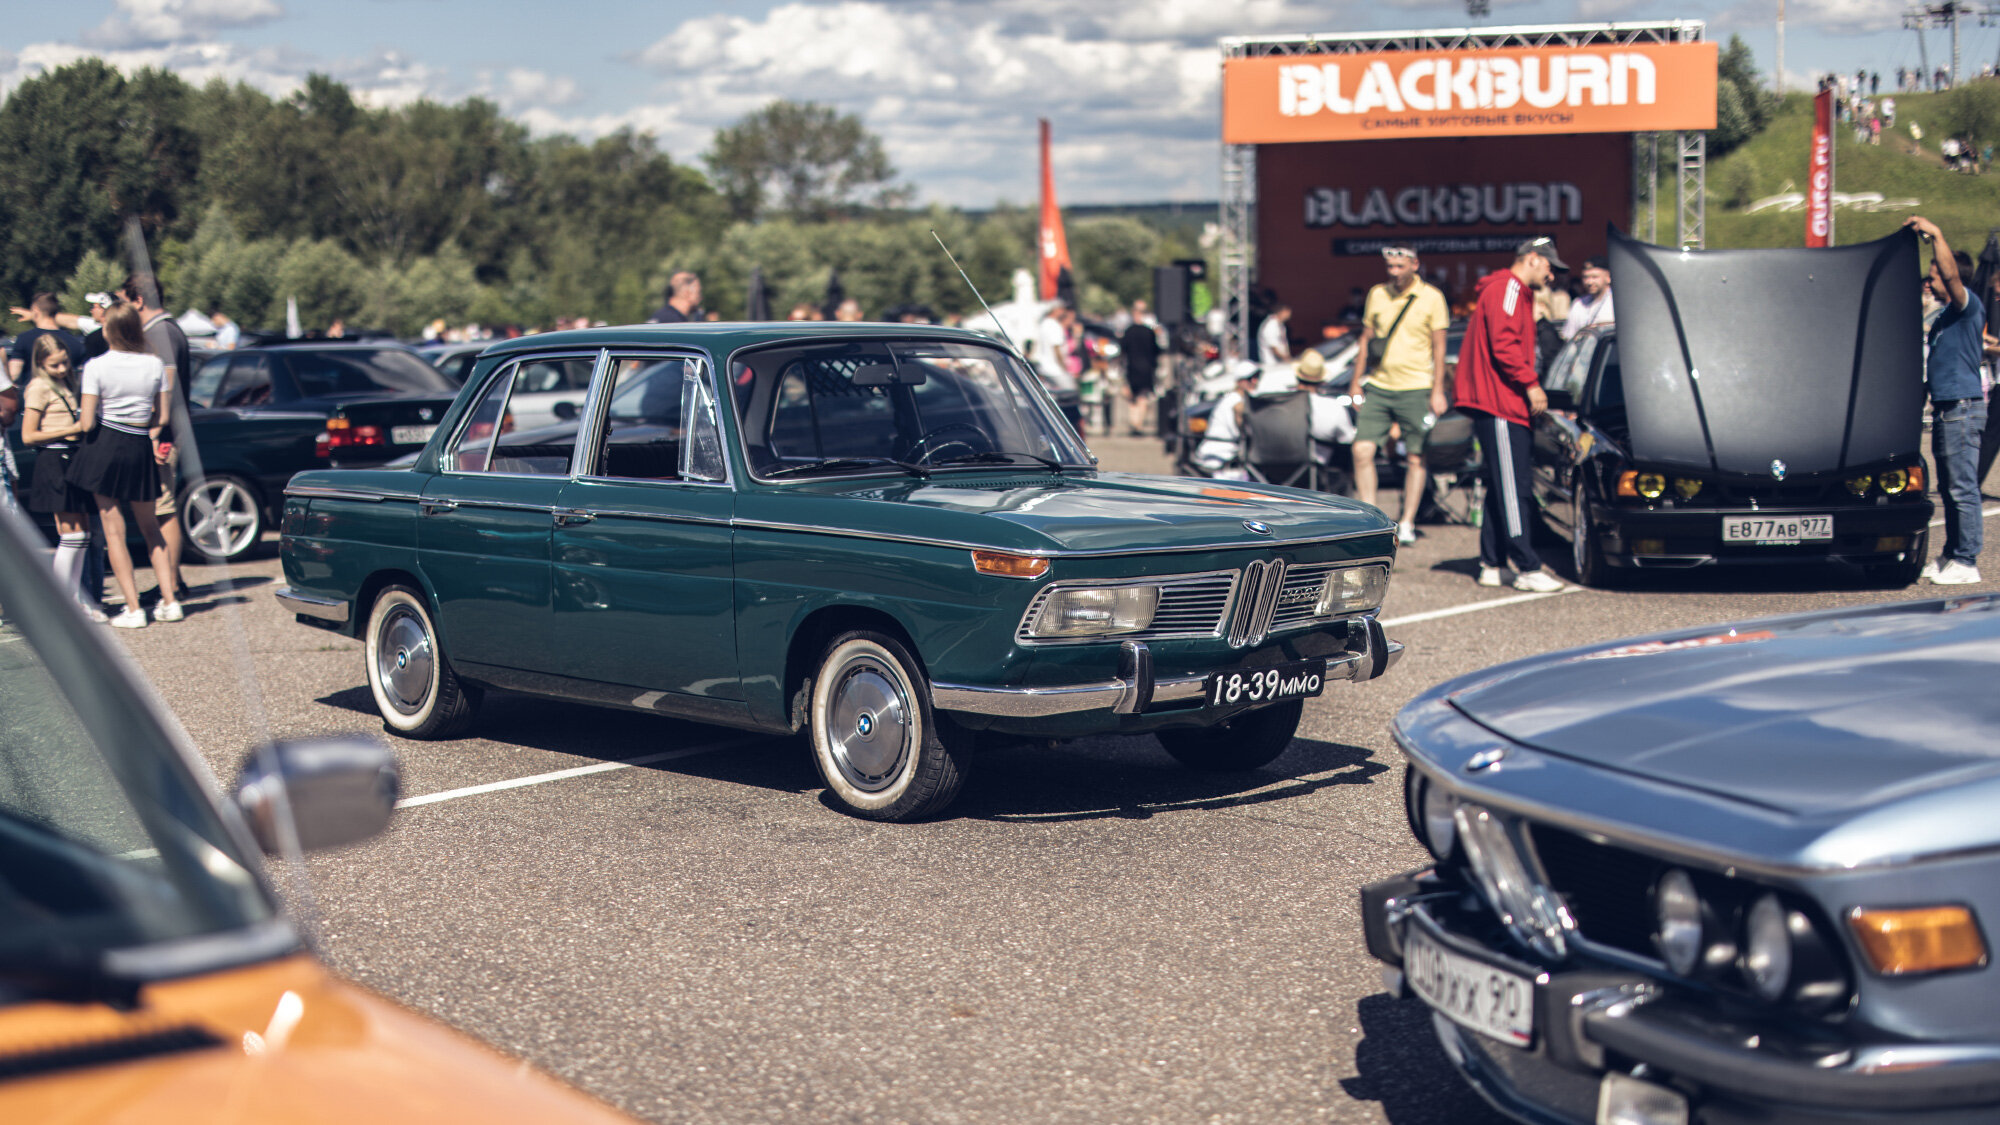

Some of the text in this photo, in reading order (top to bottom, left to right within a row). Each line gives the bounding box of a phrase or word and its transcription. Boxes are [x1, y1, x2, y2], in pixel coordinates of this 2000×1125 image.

[1279, 53, 1656, 116] BLACKBURN
[1362, 116, 1421, 130] САМЫЕ
[1514, 112, 1574, 125] ВКУСЫ
[1304, 182, 1583, 225] BLACKBURN
[1729, 518, 1828, 538] E877AB 977
[1487, 974, 1522, 1019] 90
